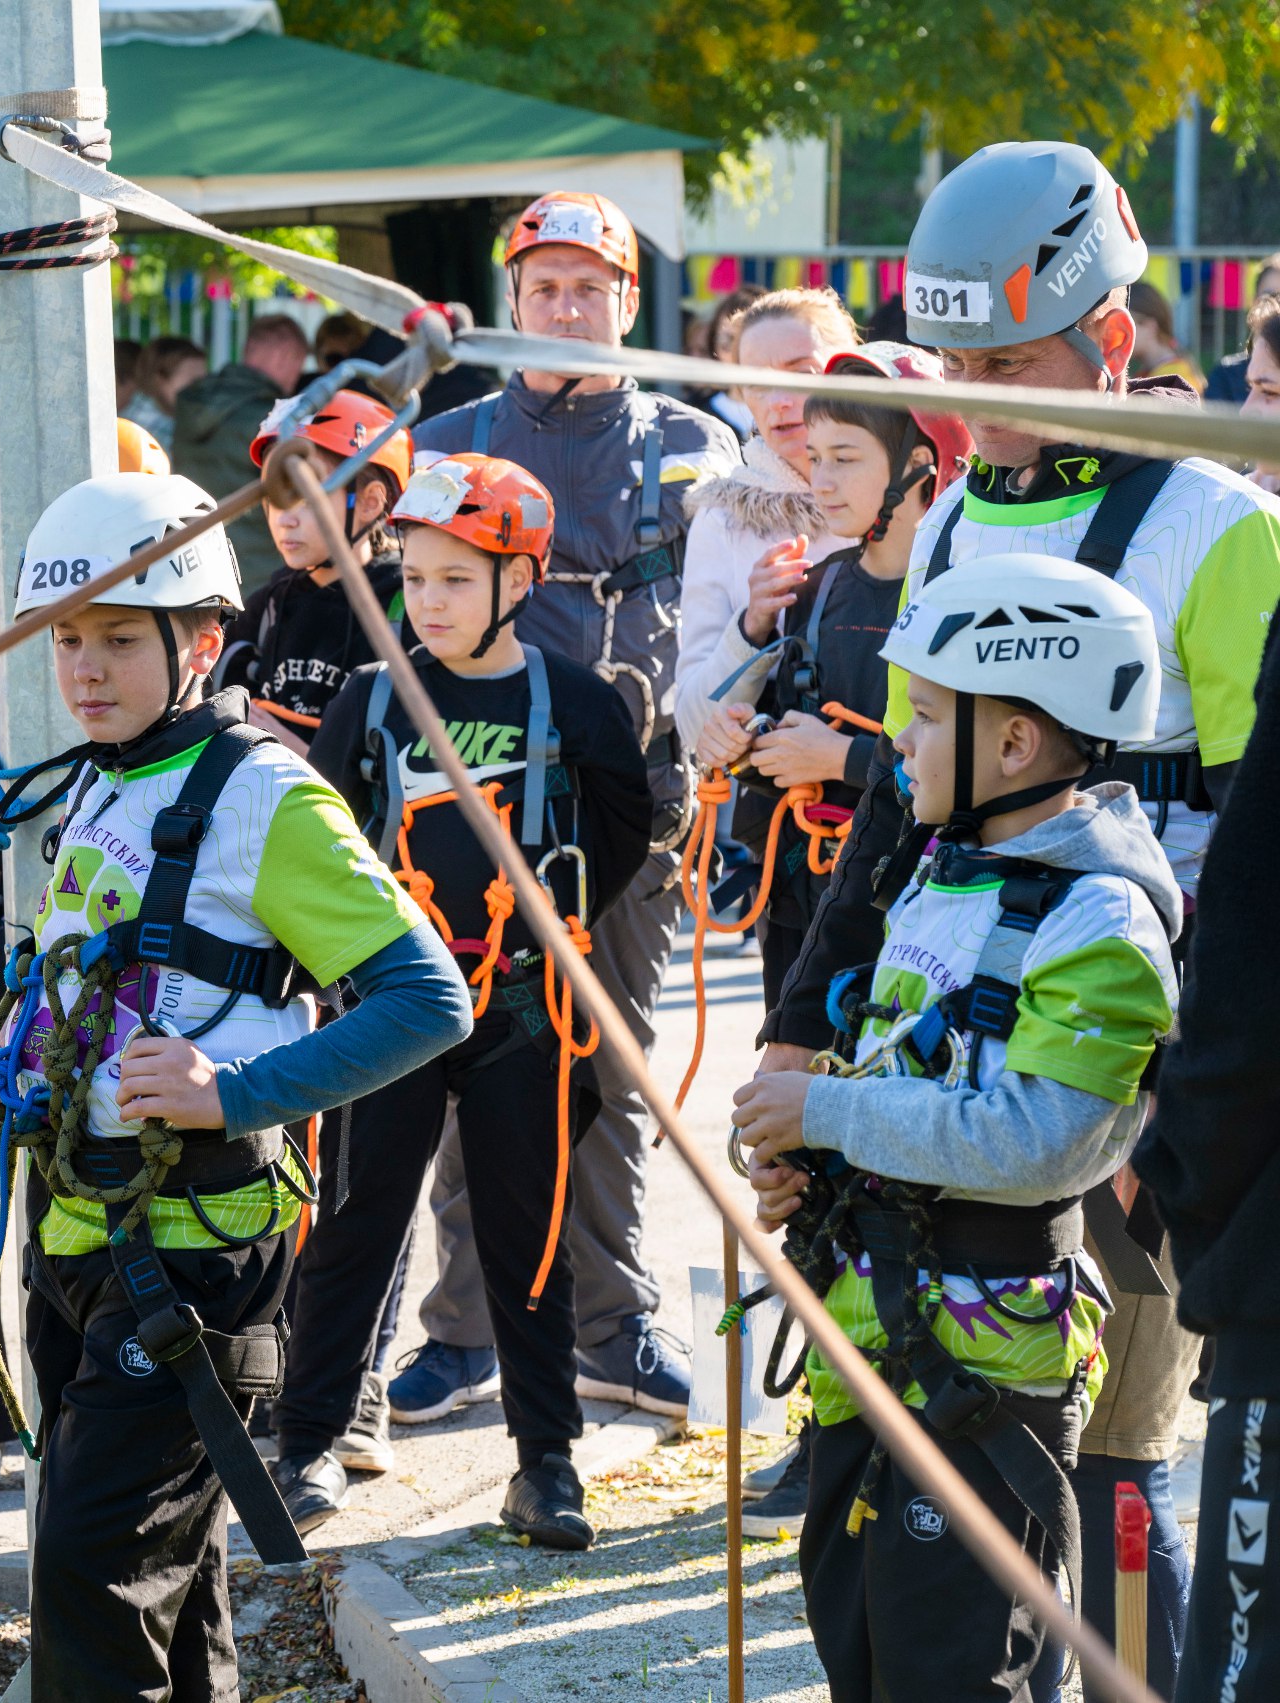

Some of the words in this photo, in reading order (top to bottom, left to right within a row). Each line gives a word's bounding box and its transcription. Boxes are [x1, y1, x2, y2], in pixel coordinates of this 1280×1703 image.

[1046, 216, 1108, 298] VENTO
[914, 286, 969, 318] 301
[31, 558, 91, 591] 208
[975, 635, 1080, 664] VENTO
[887, 943, 961, 993] ТУРИСТСКИ
[1241, 1397, 1268, 1494] EMIX
